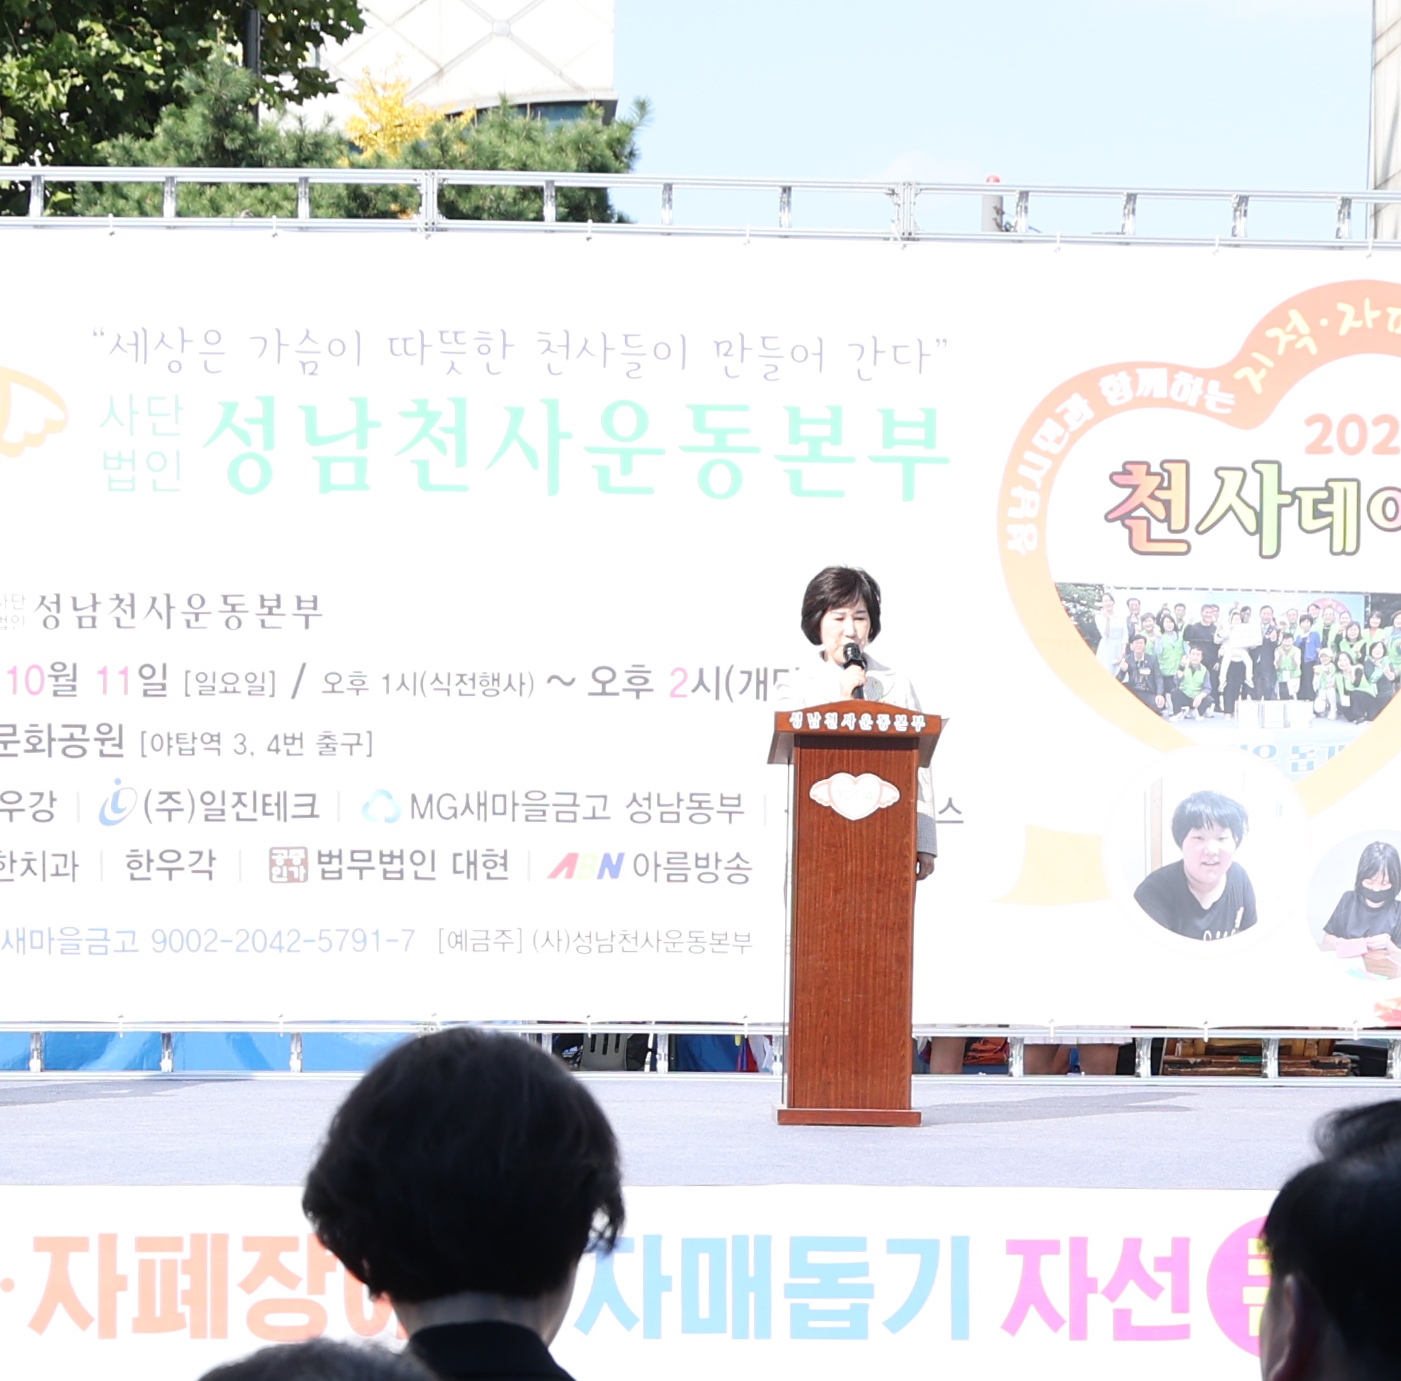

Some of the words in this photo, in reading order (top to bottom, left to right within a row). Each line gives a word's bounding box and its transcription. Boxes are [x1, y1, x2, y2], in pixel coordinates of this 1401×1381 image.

[249, 328, 360, 376] 가슴이
[388, 329, 514, 375] 따뜻한
[537, 329, 686, 379] 천사들이
[713, 332, 823, 381] 만들어
[100, 394, 184, 436] 사단
[203, 395, 950, 502] 성남천사운동본부
[1006, 392, 1094, 556] 성남시민과
[1099, 367, 1235, 413] 함께하는
[103, 450, 180, 492] 법인
[34, 592, 323, 630] 성남천사운동본부
[7, 661, 77, 697] 10월
[97, 662, 167, 698] 11일
[185, 670, 275, 698] [일요일]
[322, 671, 369, 696] 오후
[382, 670, 534, 698] 1시(식전행사)
[588, 664, 654, 700] 오후
[789, 711, 926, 732] 성남천사운동본부
[141, 731, 221, 758] [야탑역
[267, 731, 304, 756] 4번
[316, 730, 372, 758] 출구]
[144, 788, 320, 824] (주)일진테크
[411, 790, 611, 823] MG새마을금고
[625, 791, 745, 825] 성남동부
[125, 848, 217, 881] 한우각
[317, 848, 436, 881] 법무법인
[452, 848, 508, 881] 대현
[633, 851, 753, 885] 아름방송
[1, 927, 139, 955] 새마을금고
[151, 928, 415, 953] 9002-2042-5791-7
[439, 928, 522, 954] [예금주]
[533, 929, 752, 955] (사)성남천사운동본부
[573, 1234, 971, 1341] 자매돕기
[1000, 1236, 1191, 1342] 자선
